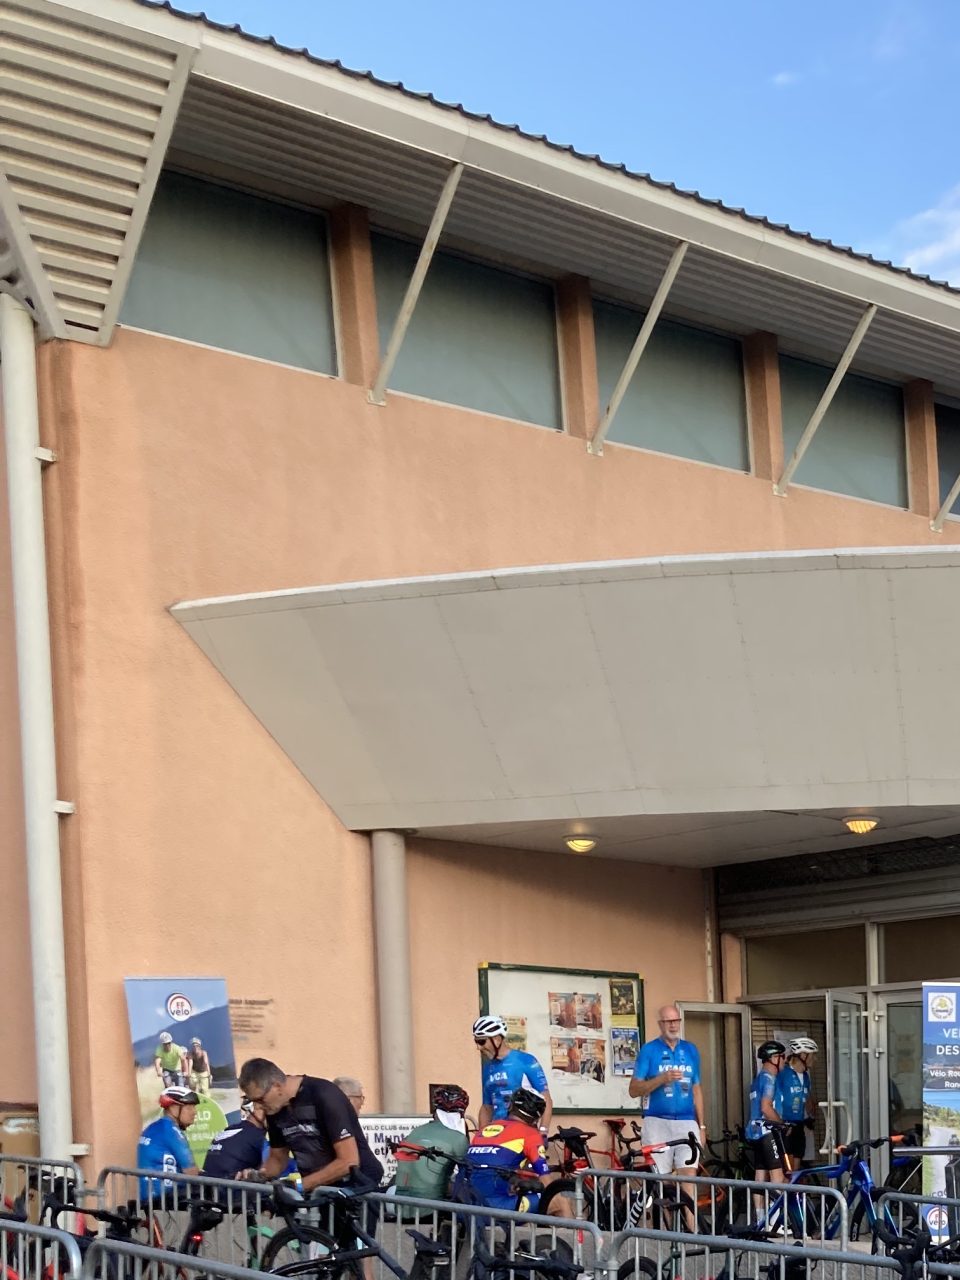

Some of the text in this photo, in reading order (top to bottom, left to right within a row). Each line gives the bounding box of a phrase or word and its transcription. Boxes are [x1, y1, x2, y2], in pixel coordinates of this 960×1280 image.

[936, 1045, 960, 1056] DES
[929, 1069, 946, 1078] Vélo
[467, 1146, 501, 1155] TREK
